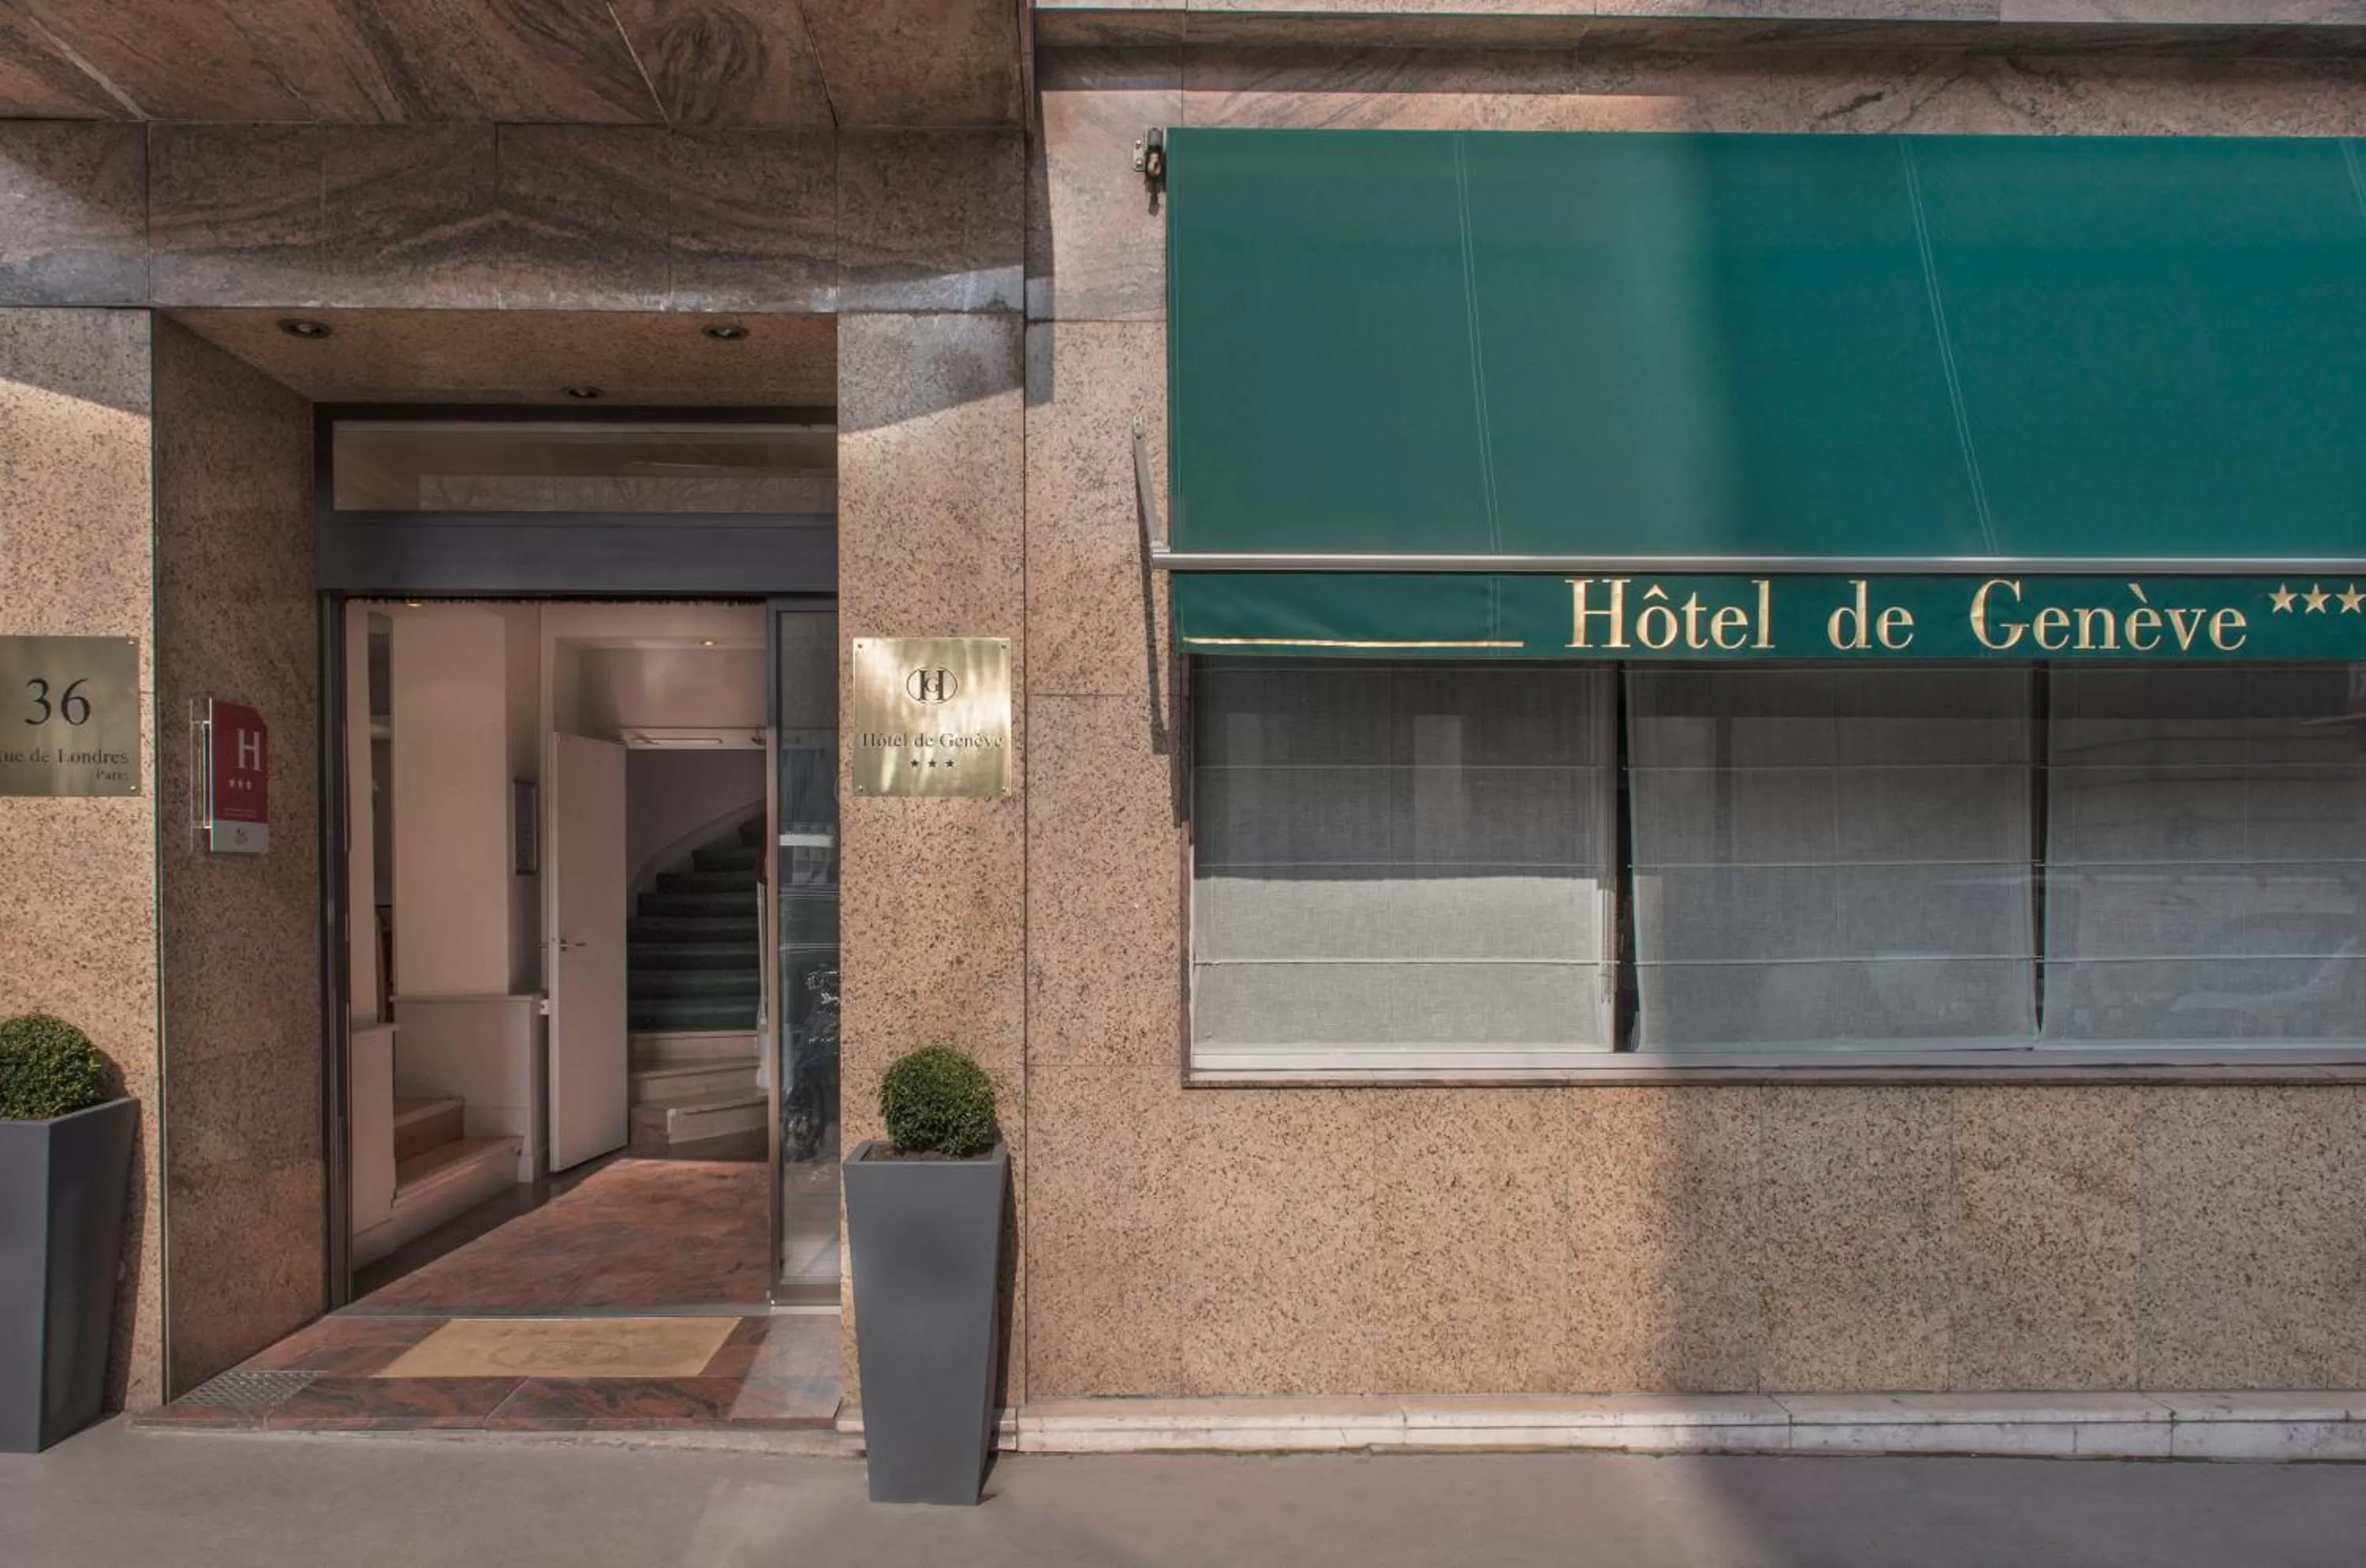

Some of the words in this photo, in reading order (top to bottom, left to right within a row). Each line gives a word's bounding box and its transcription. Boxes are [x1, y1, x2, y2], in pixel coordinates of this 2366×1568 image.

[1564, 578, 1775, 650] Hôtel
[1827, 580, 1915, 650] de
[1970, 578, 2247, 651] Genève
[24, 678, 91, 726] 36
[237, 728, 262, 771] H
[862, 733, 908, 748] Hôtel
[914, 732, 935, 748] de
[939, 732, 1003, 748] Genève
[0, 750, 24, 763] ue
[29, 748, 50, 763] de
[58, 749, 129, 765] Londres
[95, 769, 129, 781] Paris
